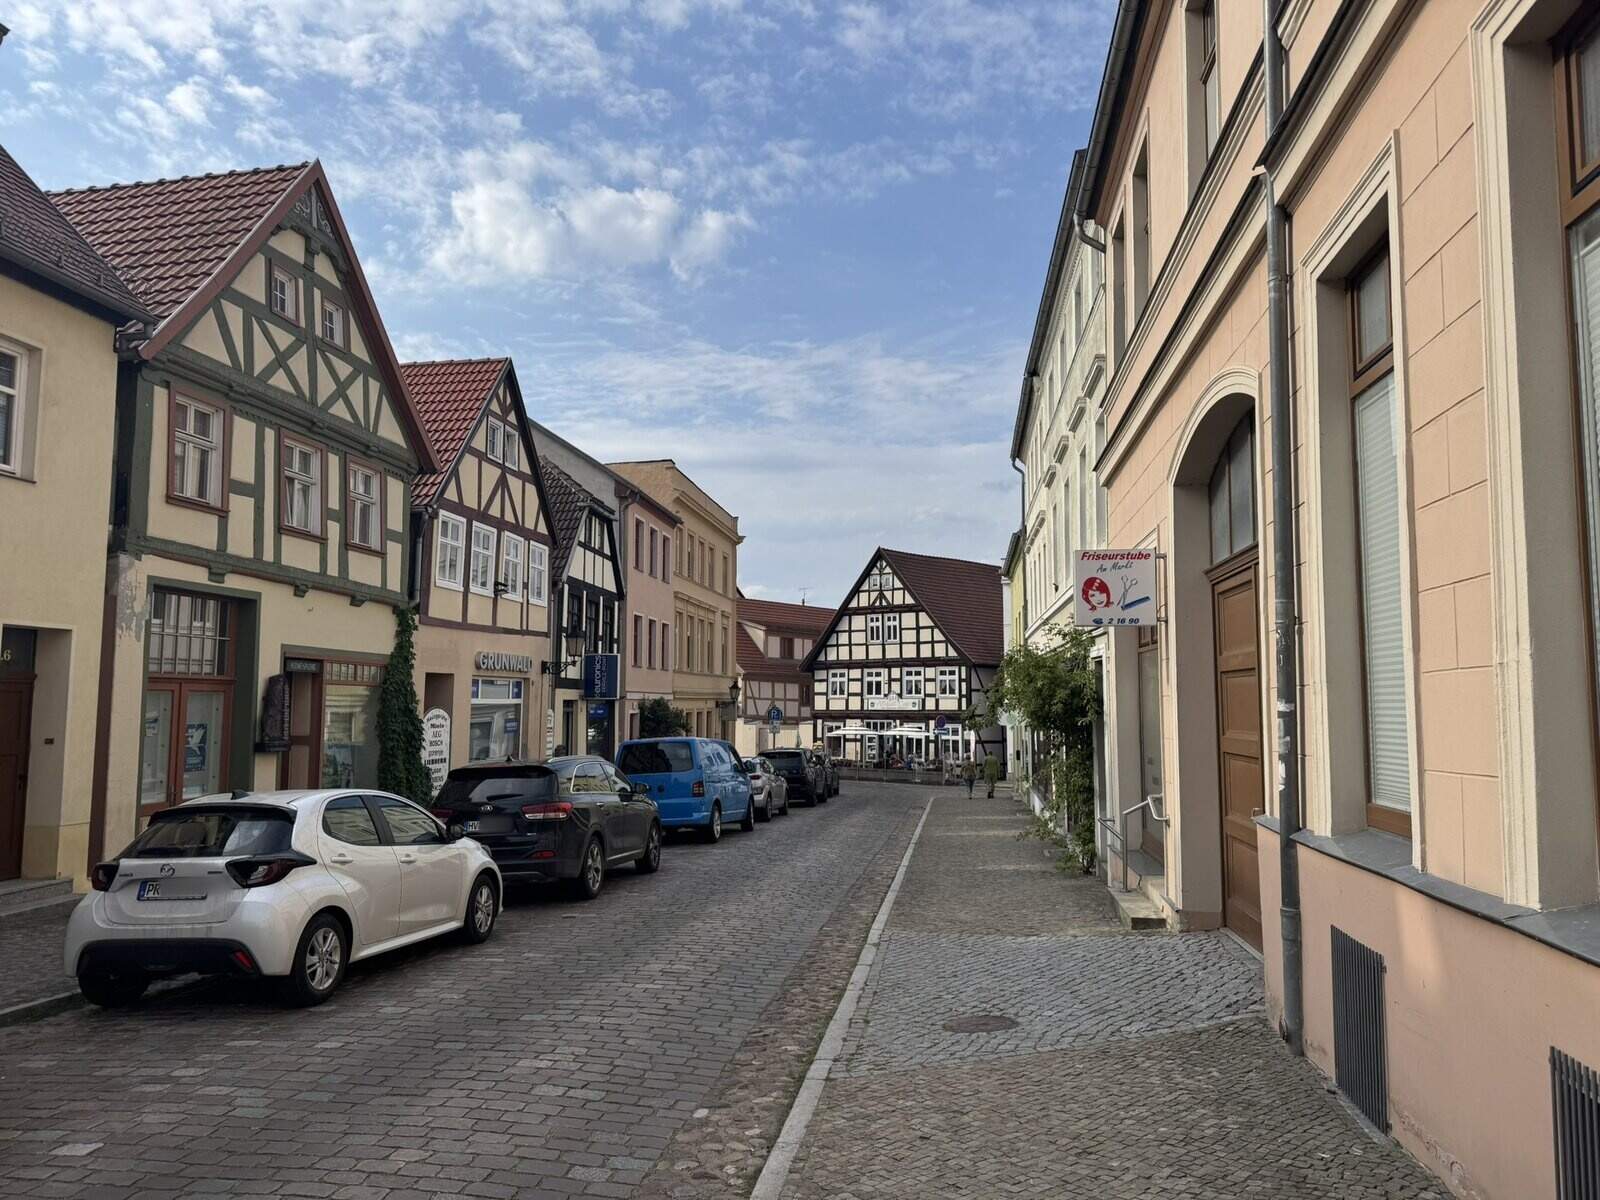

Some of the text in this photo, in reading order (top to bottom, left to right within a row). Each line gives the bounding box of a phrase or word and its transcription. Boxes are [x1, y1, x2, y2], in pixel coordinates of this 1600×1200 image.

[1081, 552, 1151, 561] Friseurstube
[1116, 617, 1126, 625] 16
[1128, 617, 1140, 625] 90
[593, 655, 602, 693] euronics
[432, 731, 442, 739] AEG
[429, 740, 443, 748] BOSCH
